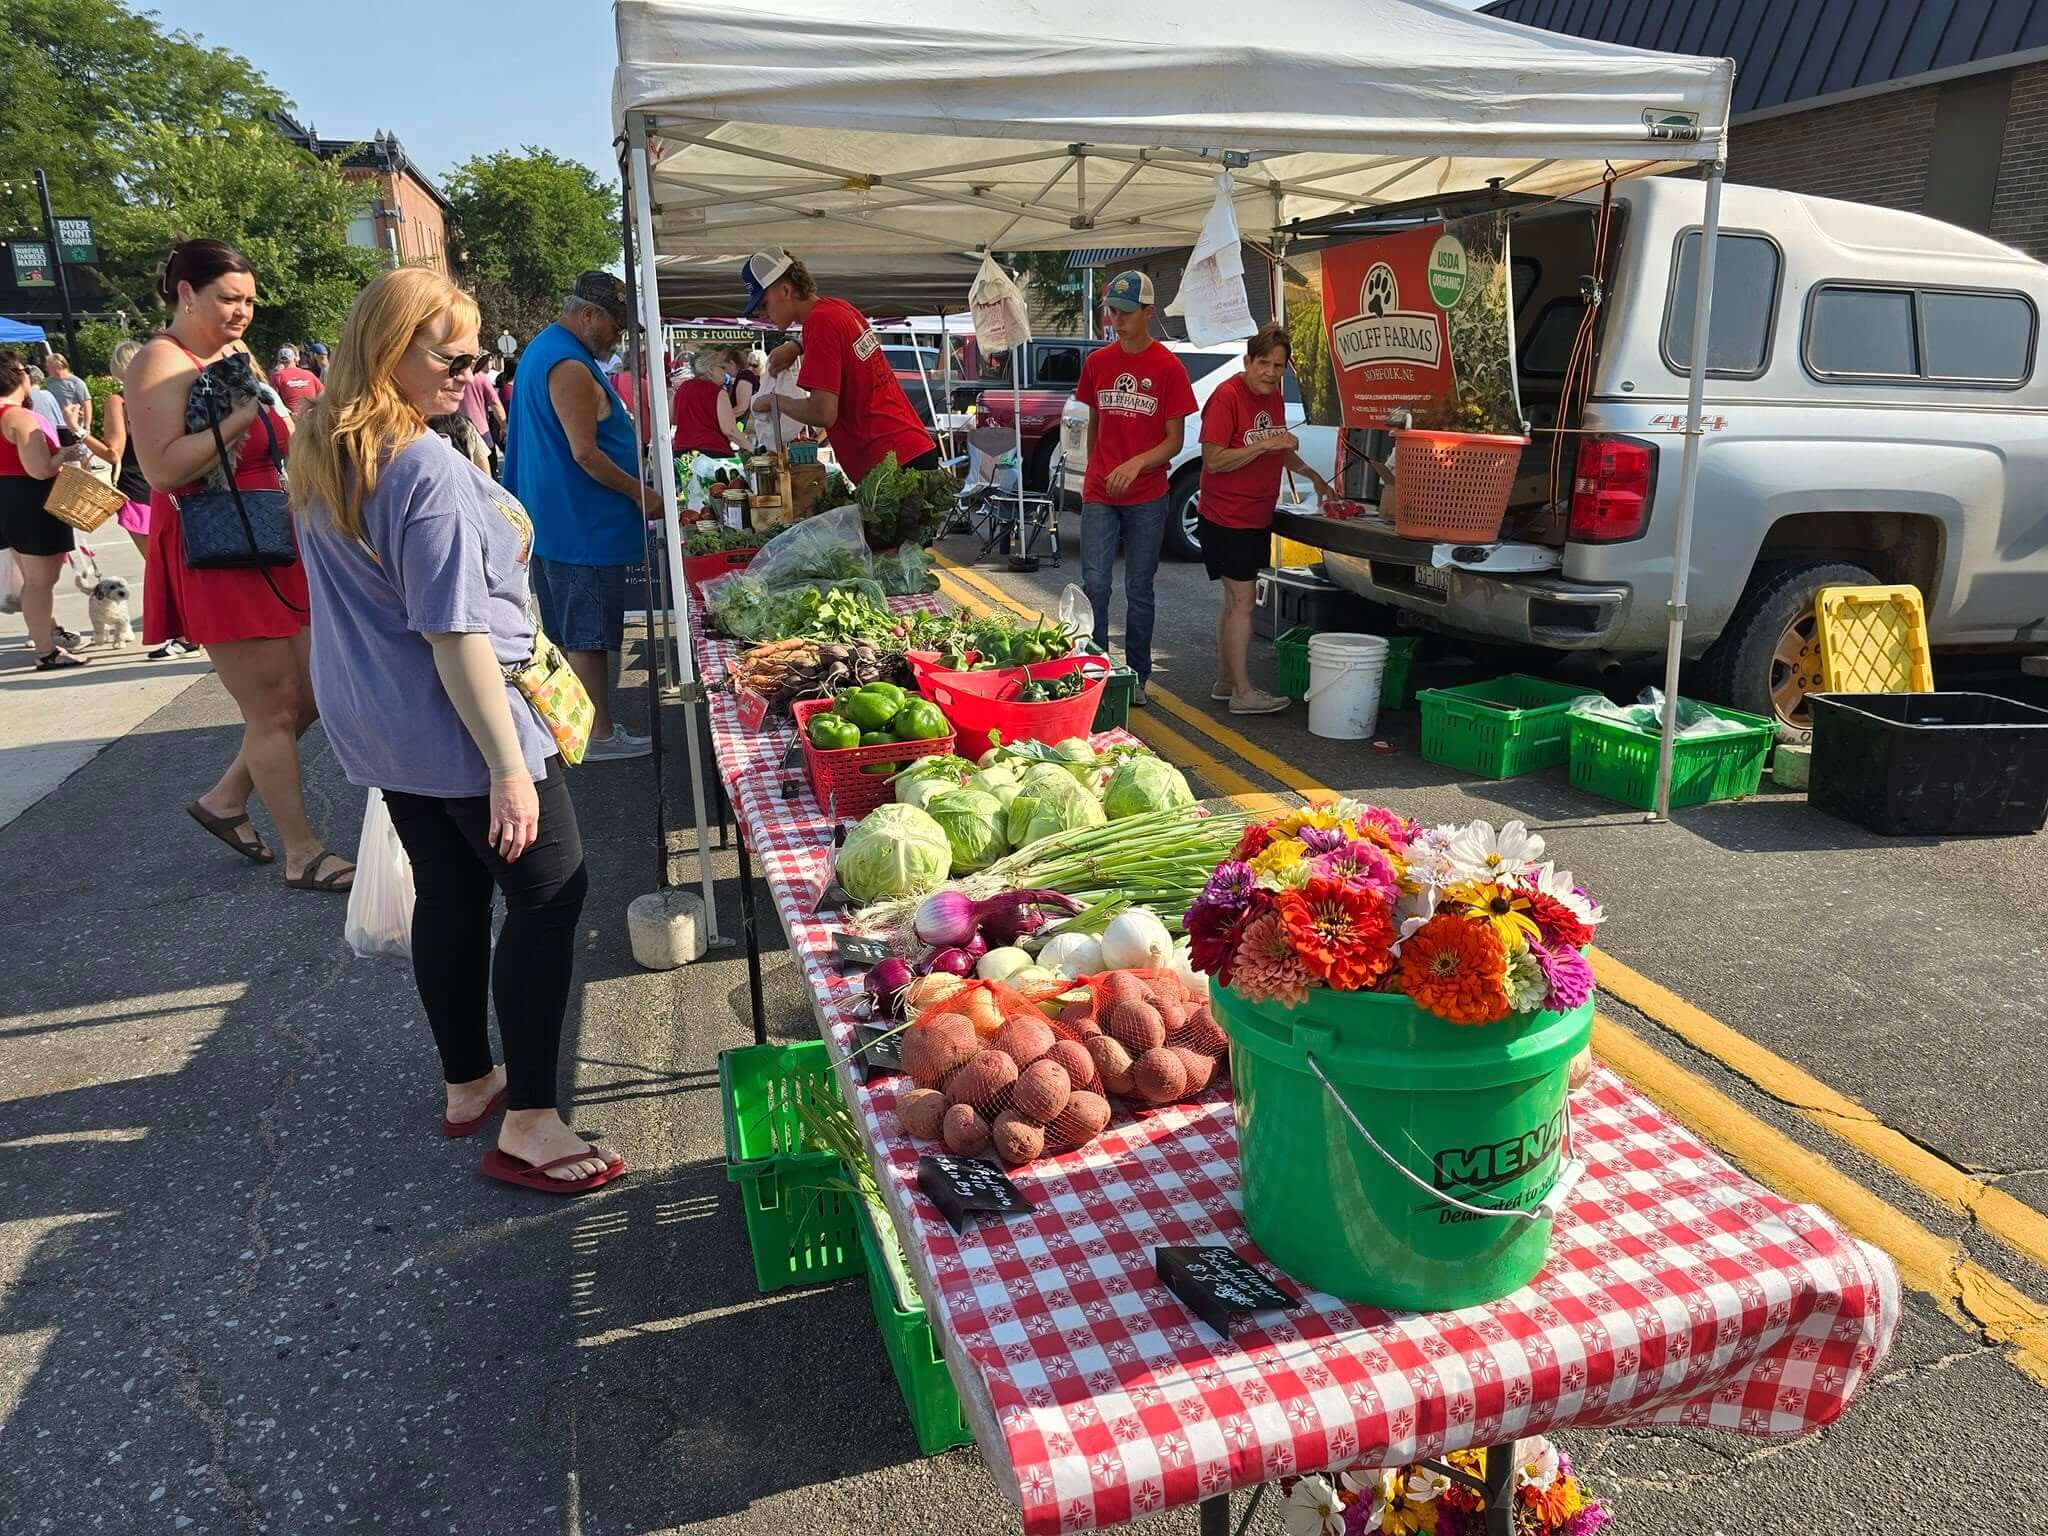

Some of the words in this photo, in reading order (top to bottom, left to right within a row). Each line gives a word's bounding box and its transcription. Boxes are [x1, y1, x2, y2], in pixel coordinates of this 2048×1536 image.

[58, 220, 88, 229] RIVER
[60, 229, 90, 238] POINT
[62, 238, 93, 246] SQUARE
[1437, 250, 1460, 270] USDA
[1432, 272, 1462, 291] ORGANIC
[1337, 327, 1381, 356] WOLFF
[1384, 326, 1433, 354] FARMS
[1525, 1188, 1538, 1203] to
[1213, 1248, 1240, 1266] Cut
[1236, 1268, 1287, 1302] Flower
